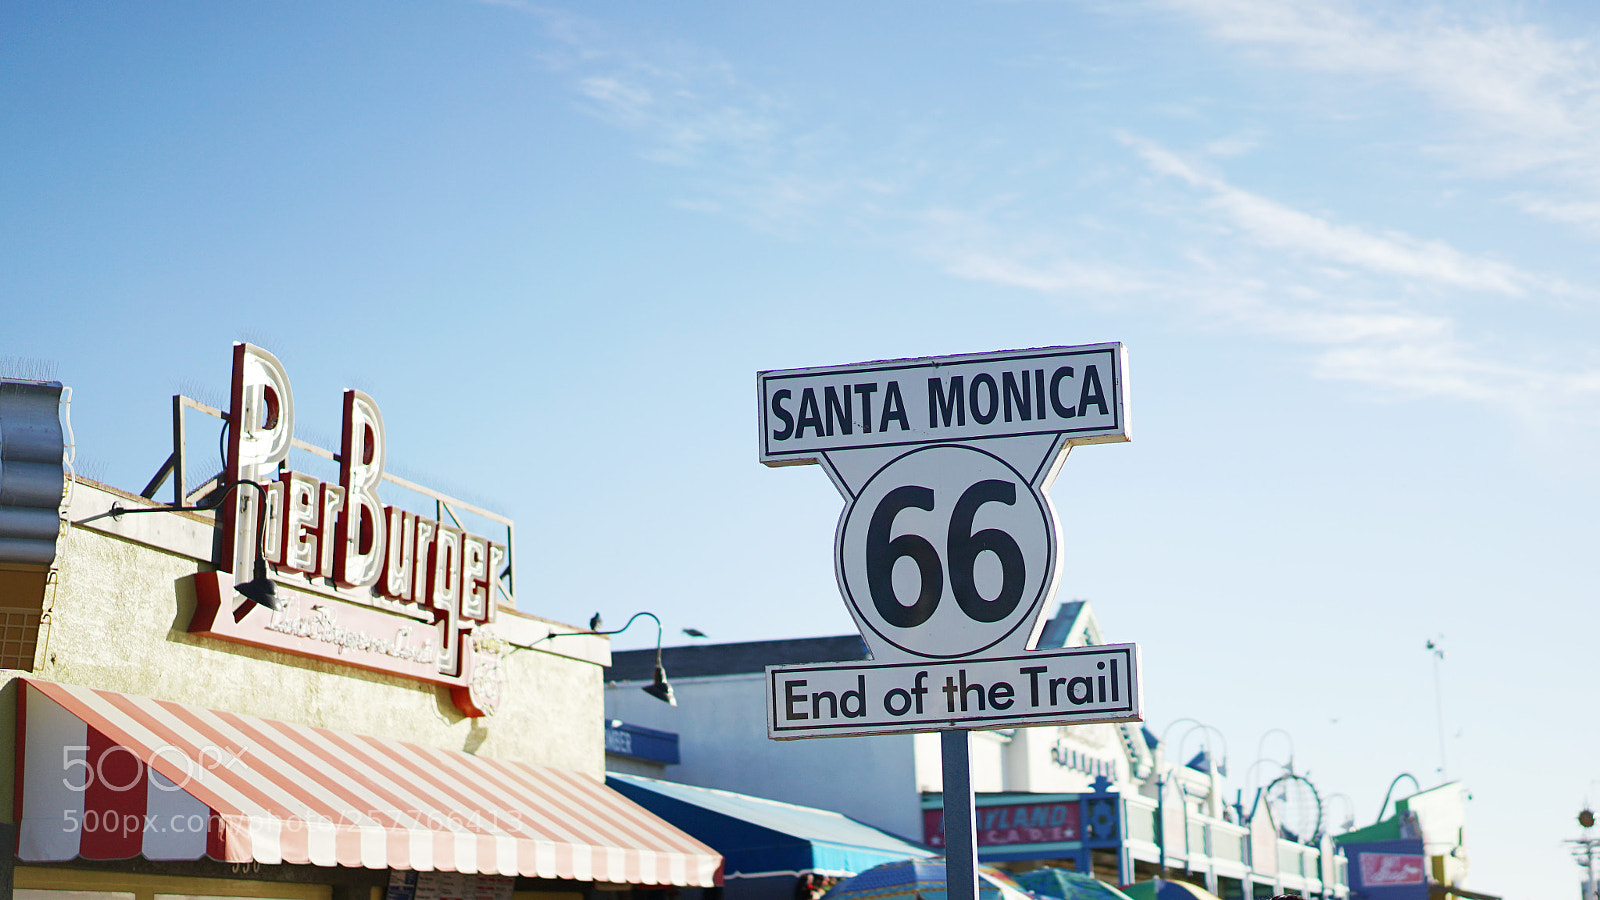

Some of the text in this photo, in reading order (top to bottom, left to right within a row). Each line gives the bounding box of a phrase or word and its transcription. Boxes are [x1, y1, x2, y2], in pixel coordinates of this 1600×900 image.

[771, 364, 1109, 441] SANTA MONICA
[866, 478, 1026, 629] 66
[784, 658, 1120, 721] End of the Trail
[938, 805, 1067, 833] YLAND
